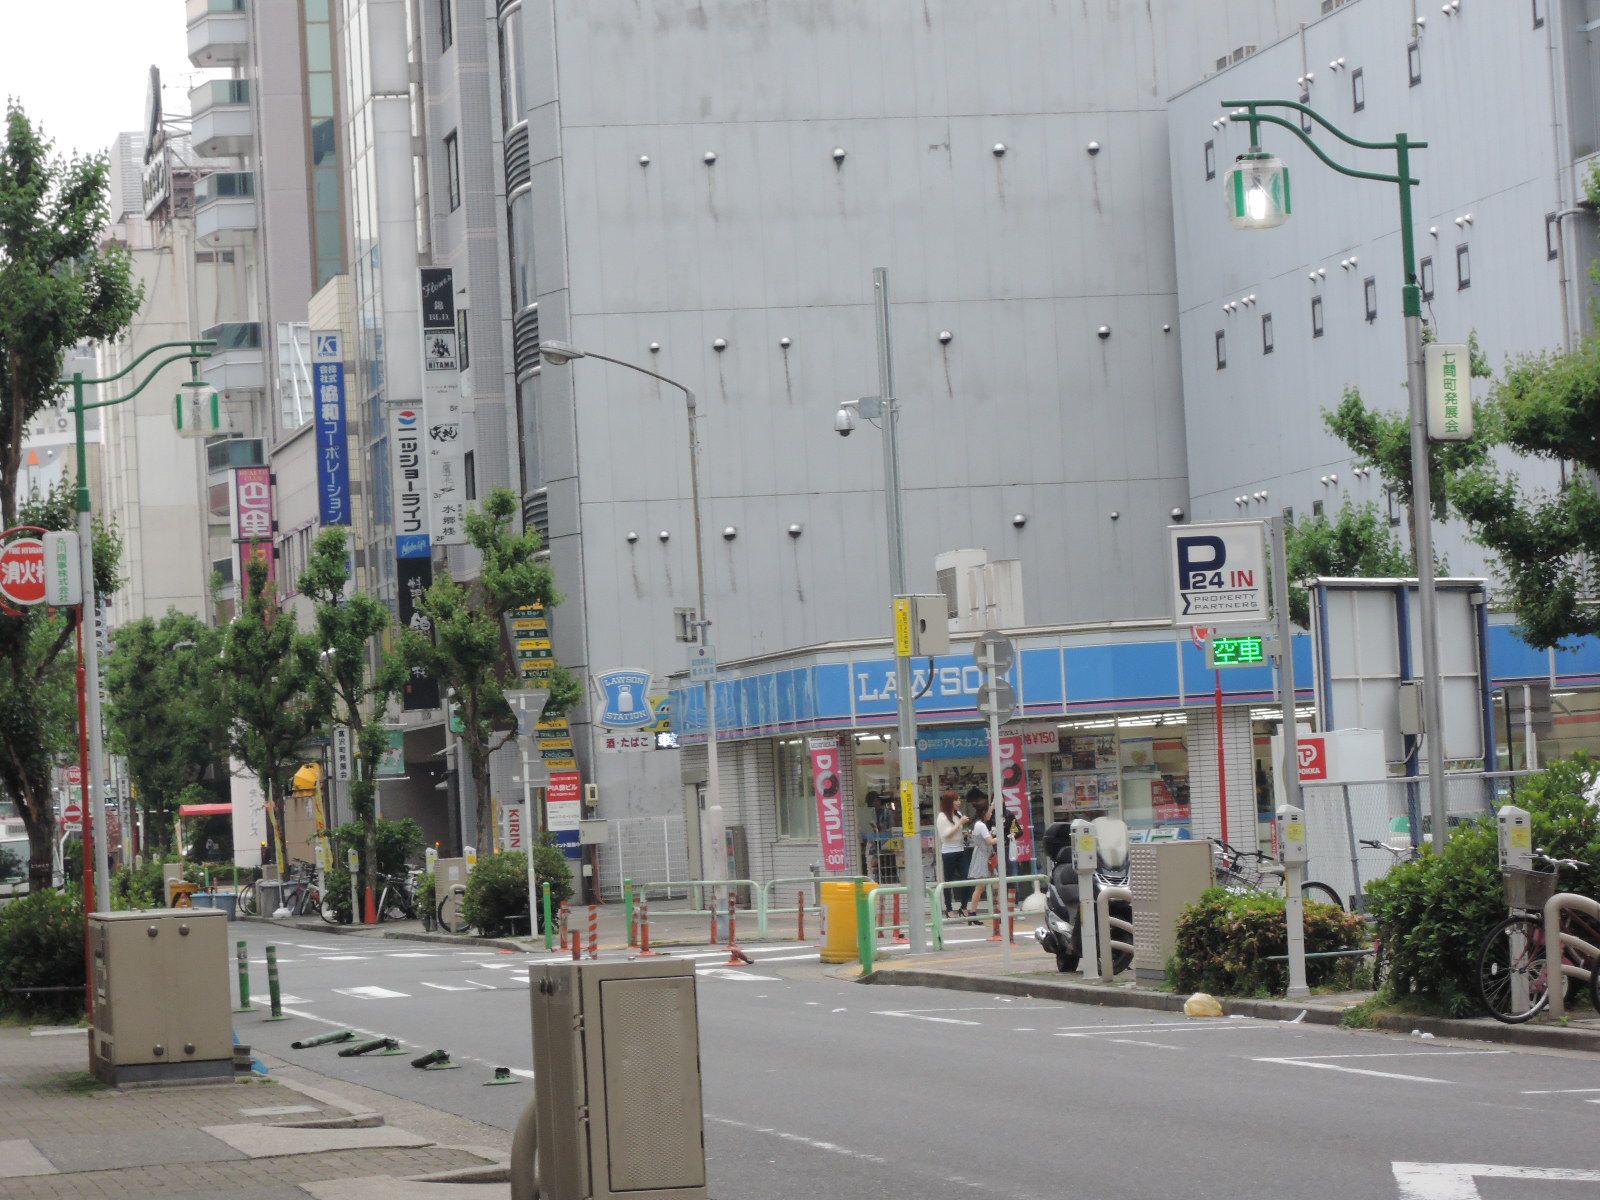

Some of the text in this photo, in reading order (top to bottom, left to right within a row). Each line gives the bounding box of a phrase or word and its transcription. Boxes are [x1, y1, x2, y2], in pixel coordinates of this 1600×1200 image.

[1176, 535, 1227, 590] P
[1191, 569, 1254, 590] 24 IN
[1194, 593, 1256, 602] PROPERTY
[1194, 602, 1258, 610] PARTNERS
[1212, 636, 1263, 666] 空車
[604, 675, 645, 687] LAWSON
[606, 709, 647, 721] STATION
[606, 736, 649, 749] 酒・たばこ
[508, 808, 520, 848] KIRIN
